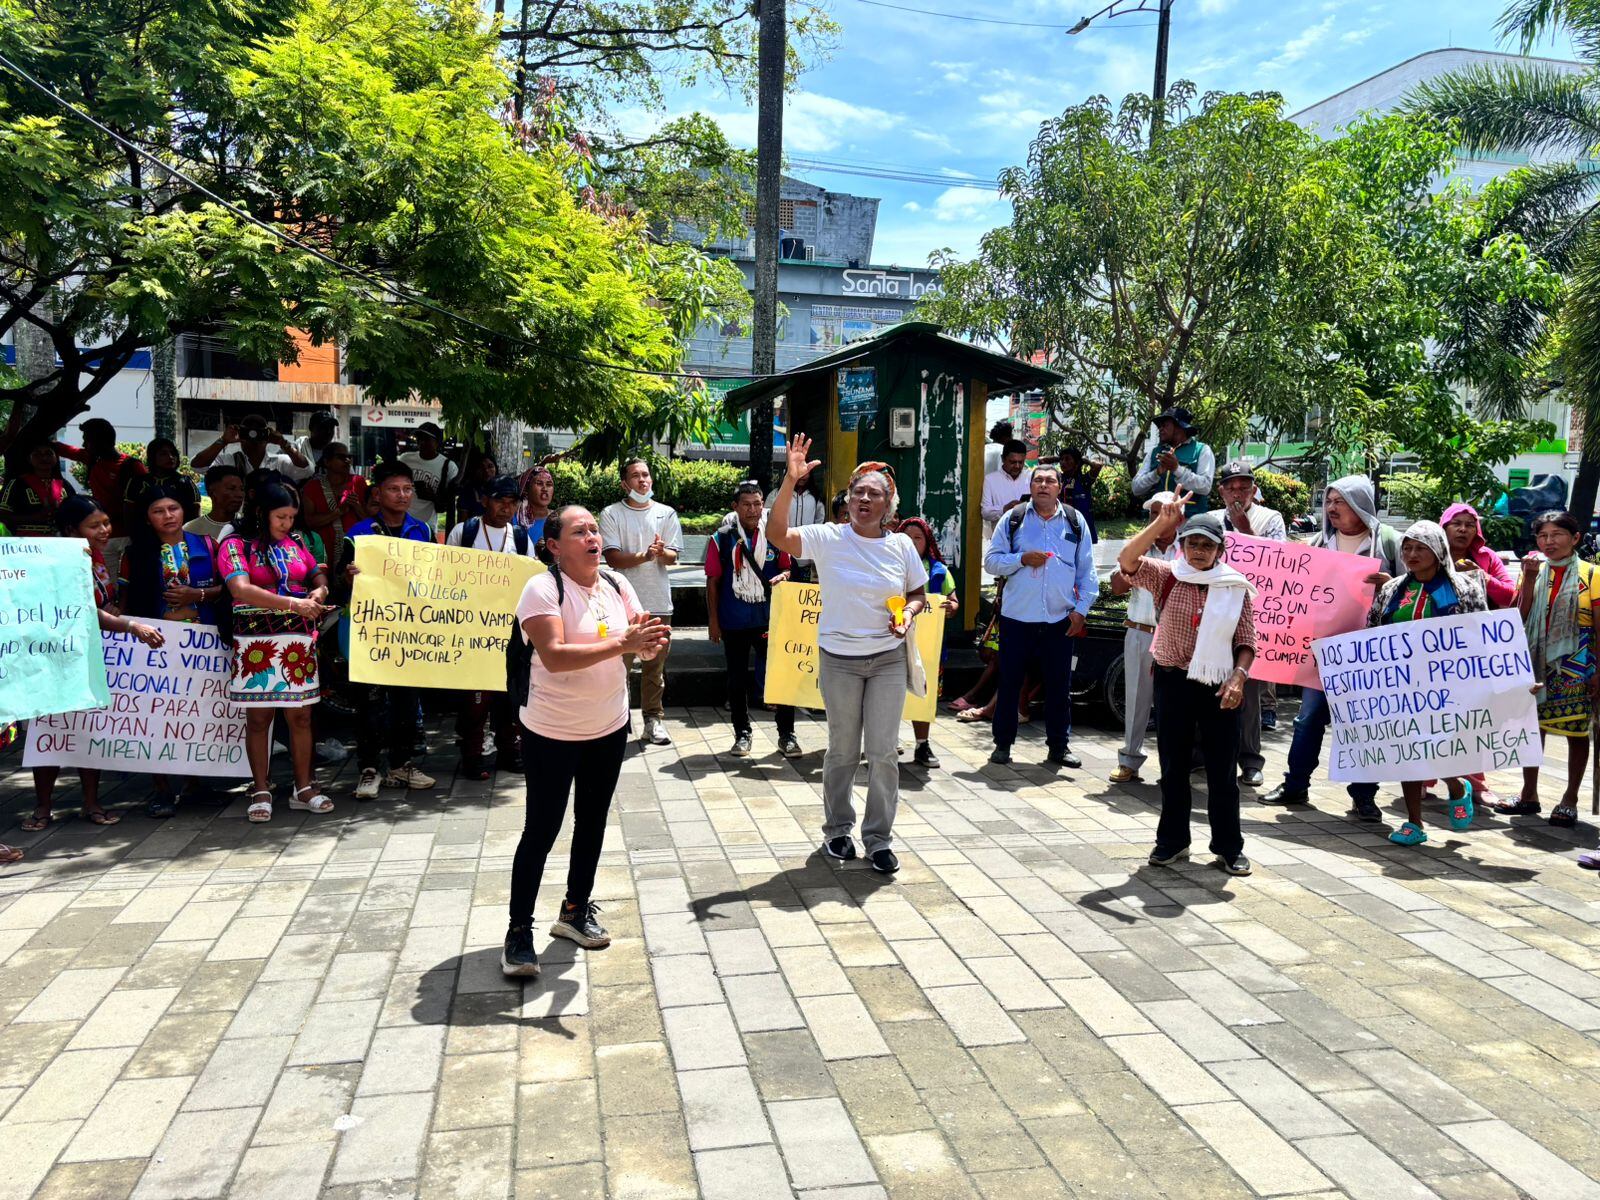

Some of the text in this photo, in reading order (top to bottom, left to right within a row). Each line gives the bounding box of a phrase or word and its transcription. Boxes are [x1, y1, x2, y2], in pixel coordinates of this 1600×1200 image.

[841, 269, 909, 295] Santa
[413, 545, 471, 564] ESTADO
[0, 569, 26, 580] TUYE
[428, 566, 443, 582] LA
[449, 571, 511, 587] JUSTICIA
[407, 581, 468, 602] NO LLEGA
[1281, 580, 1304, 597] NO
[1310, 585, 1335, 604] ES
[353, 599, 415, 624] ¿HASTA
[420, 605, 474, 625] CUANDO
[1263, 596, 1308, 615] ES UN
[358, 625, 368, 641] A
[451, 634, 465, 648] LA
[1275, 632, 1296, 647] NO
[1322, 619, 1515, 667] LOS JUECES QUE NO
[28, 640, 59, 657] CON
[102, 642, 134, 666] ÉN
[147, 650, 168, 669] ES
[369, 647, 391, 662] CIA
[784, 640, 813, 656] CADA
[1265, 649, 1309, 665] CUMPLE
[1429, 651, 1532, 684] PROTEGEN
[106, 670, 193, 696] UCIONAL!
[151, 697, 200, 717] PARA
[212, 700, 247, 719] QUE
[1330, 703, 1346, 724] AL
[164, 721, 195, 741] NO
[202, 723, 247, 743] PARA
[1336, 708, 1493, 745] UNA JUSTICIA LENTA
[37, 734, 242, 764] QUE MIREN AL TECHO
[1338, 750, 1356, 769] ES
[1357, 748, 1386, 768] UNA
[1389, 738, 1467, 764] JUSTICIA
[1493, 748, 1521, 769] DA
